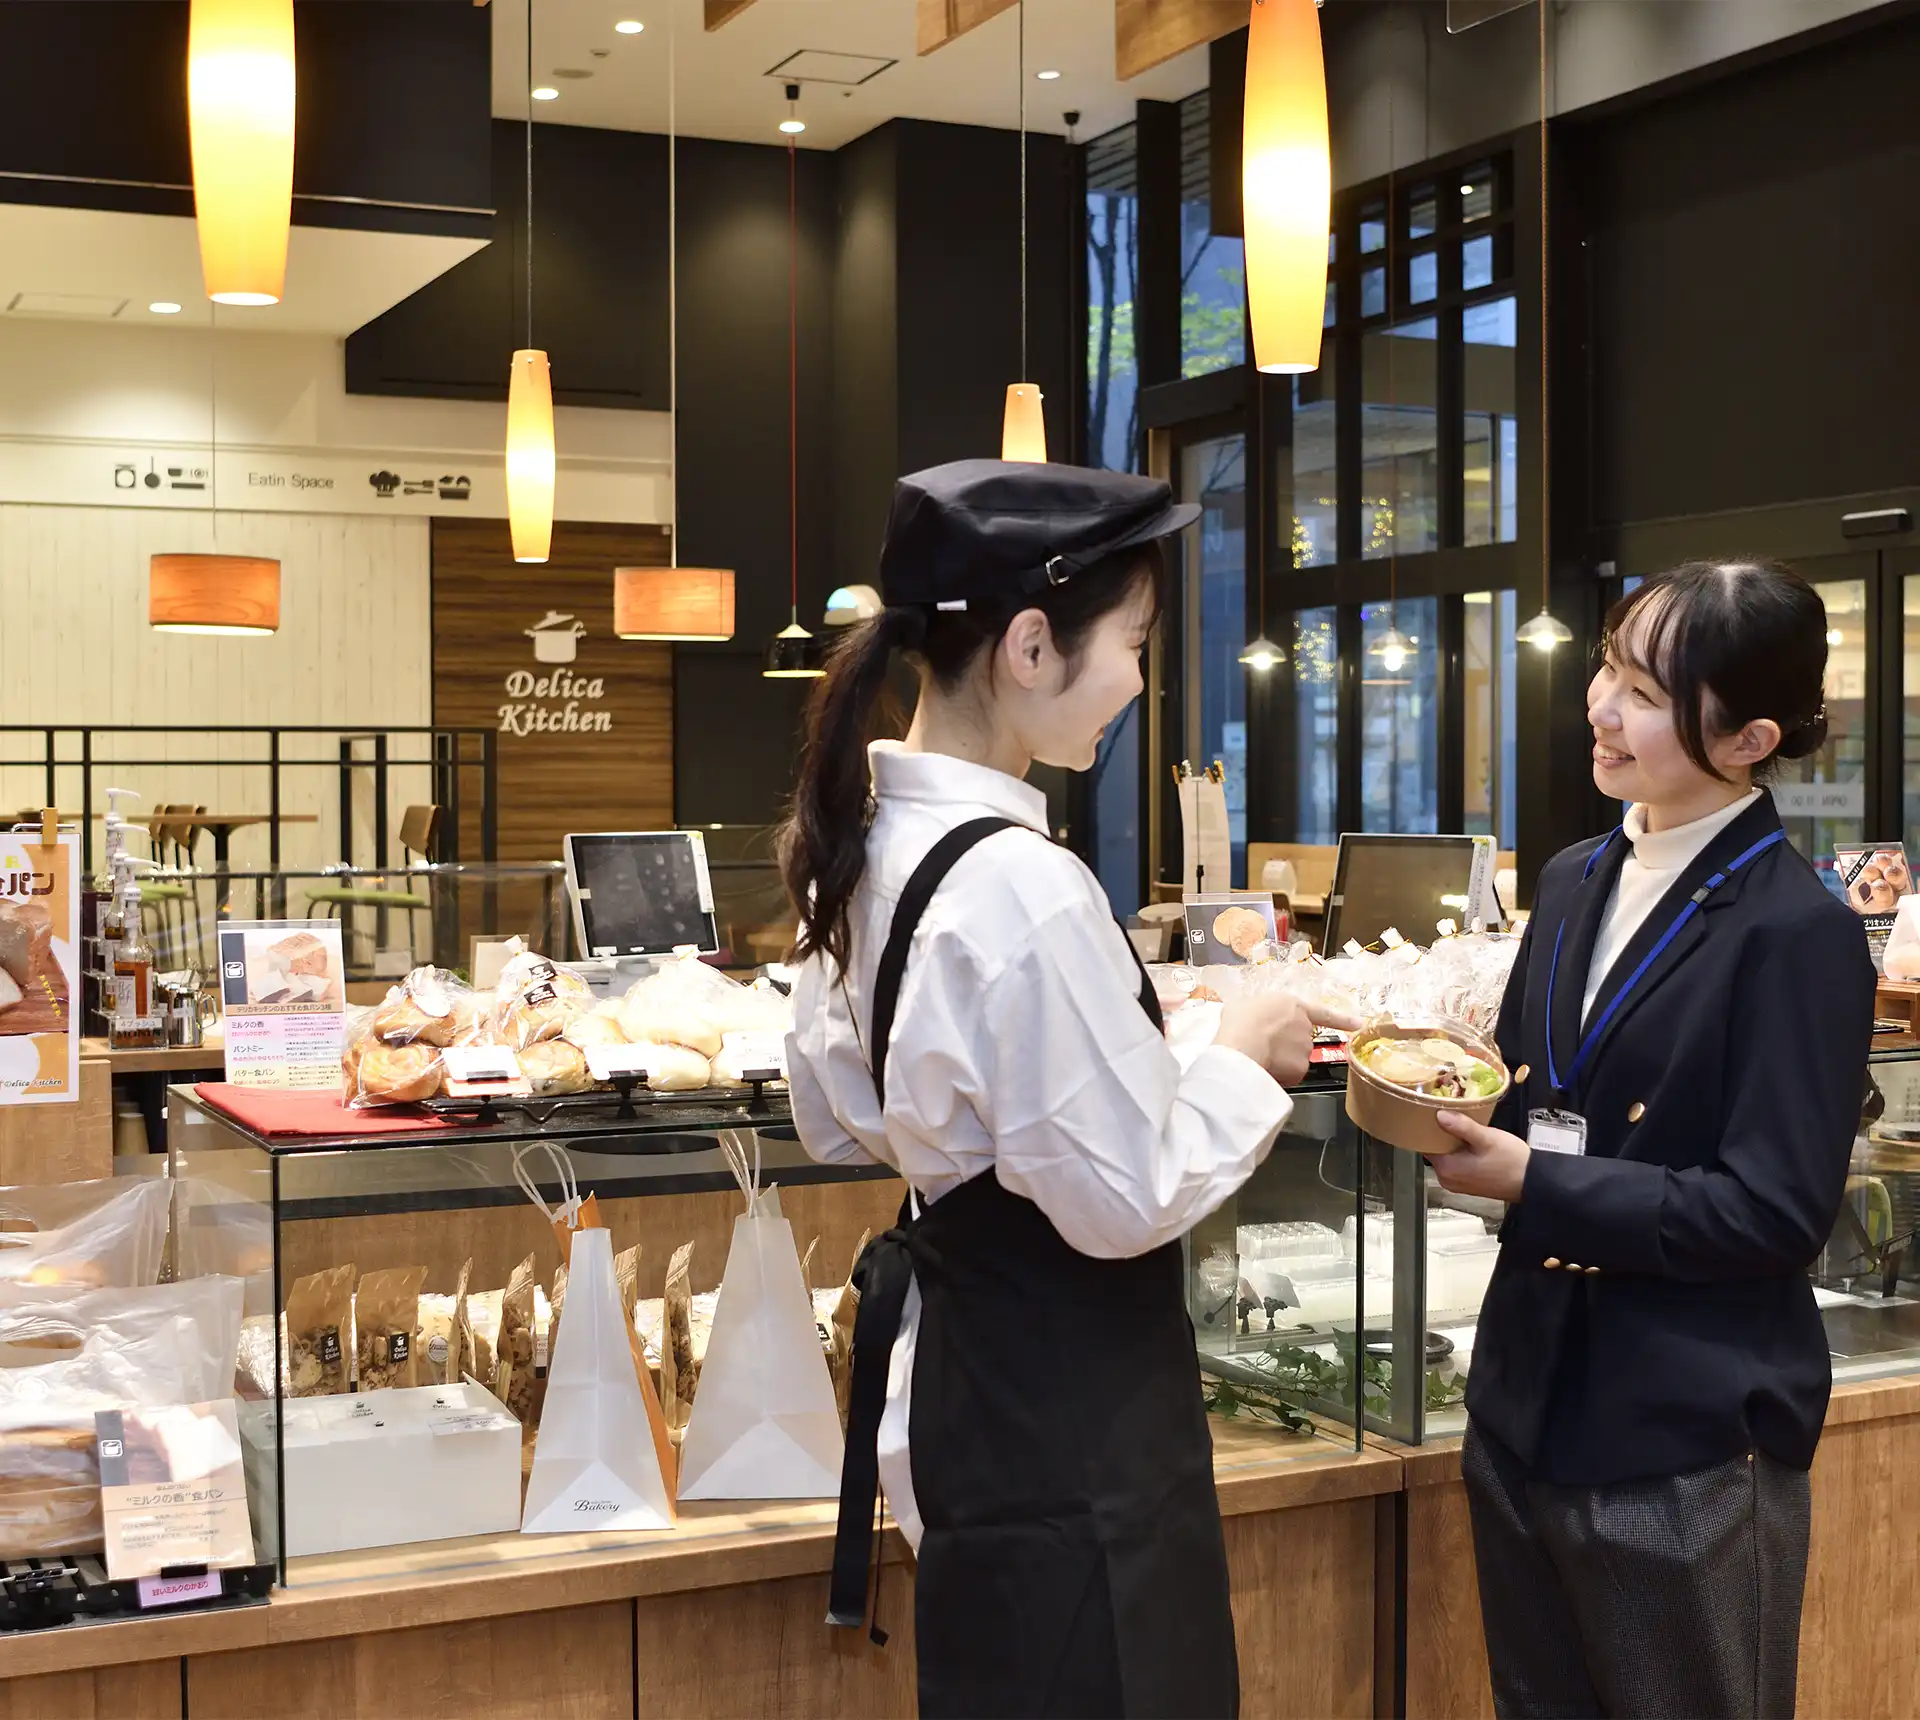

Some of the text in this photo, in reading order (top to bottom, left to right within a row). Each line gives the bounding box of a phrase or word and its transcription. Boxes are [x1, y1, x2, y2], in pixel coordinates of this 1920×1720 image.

[248, 471, 334, 490] Eatin Space
[505, 667, 604, 699] Delica
[497, 701, 613, 737] Kitchen
[234, 1068, 275, 1077] バター食パン
[573, 1499, 620, 1512] Bakery
